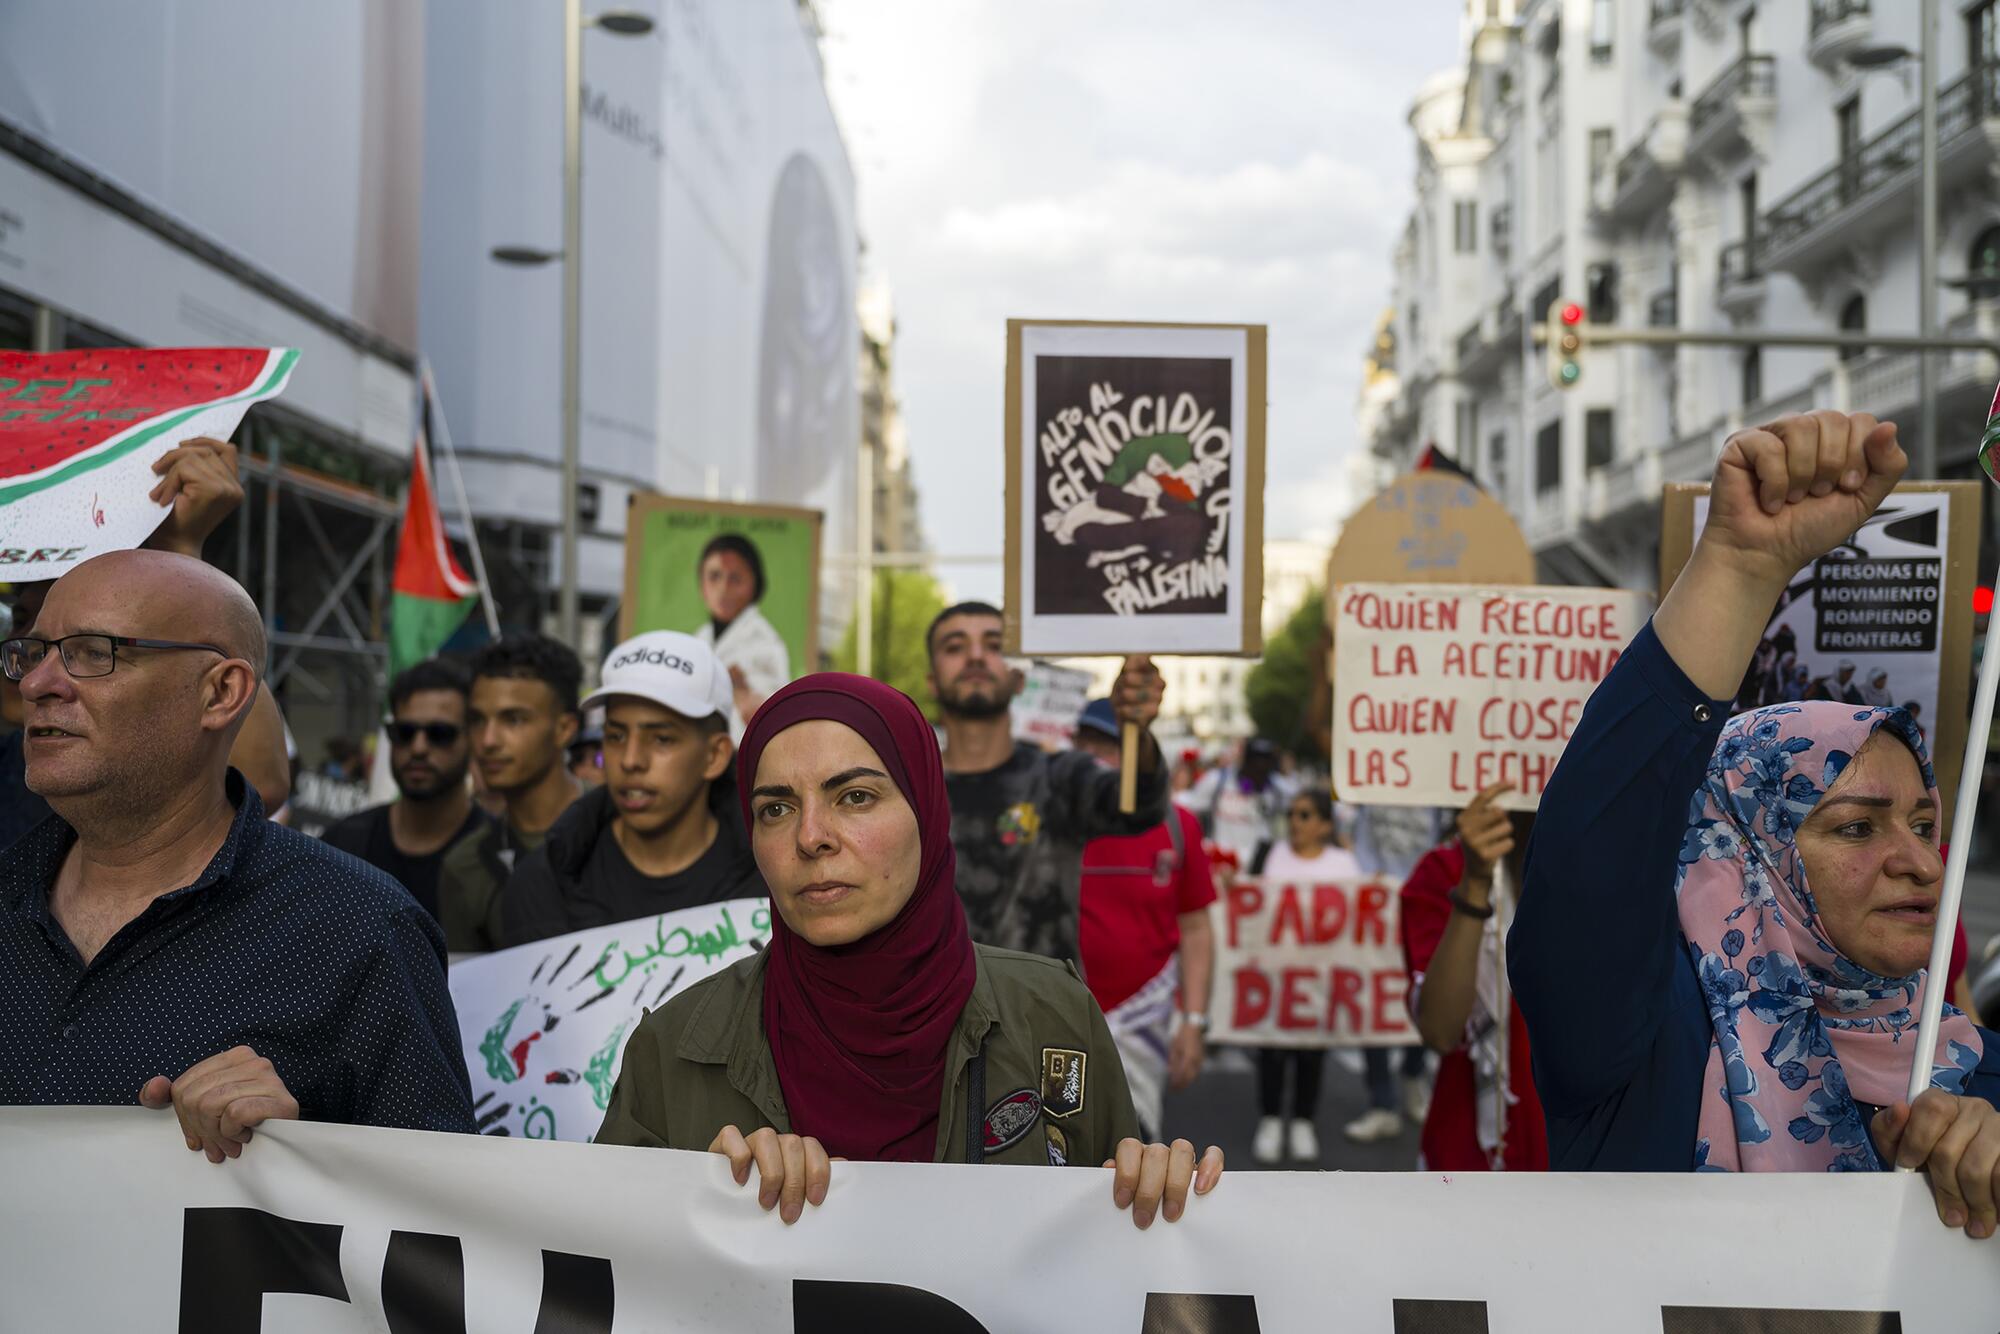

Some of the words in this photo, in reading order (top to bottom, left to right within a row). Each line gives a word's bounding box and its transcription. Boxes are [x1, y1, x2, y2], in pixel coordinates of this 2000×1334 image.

[1040, 407, 1083, 467] ALTO
[1090, 382, 1123, 416] AL
[1048, 393, 1231, 511] GENOCIDIO
[1103, 553, 1228, 617] PALESTINA
[1821, 563, 1912, 580] PERSONAS
[1916, 563, 1939, 579] EN
[1821, 586, 1937, 602] MOVIMIENTO
[1481, 597, 1621, 641] RECOGE
[1823, 608, 1932, 625] ROMPIENDO
[1821, 631, 1923, 647] FRONTERAS
[613, 646, 694, 676] adidas
[1372, 645, 1419, 677] LA
[1348, 750, 1411, 787] LAS
[1450, 751, 1555, 795] LECH
[1226, 884, 1403, 950] PADR
